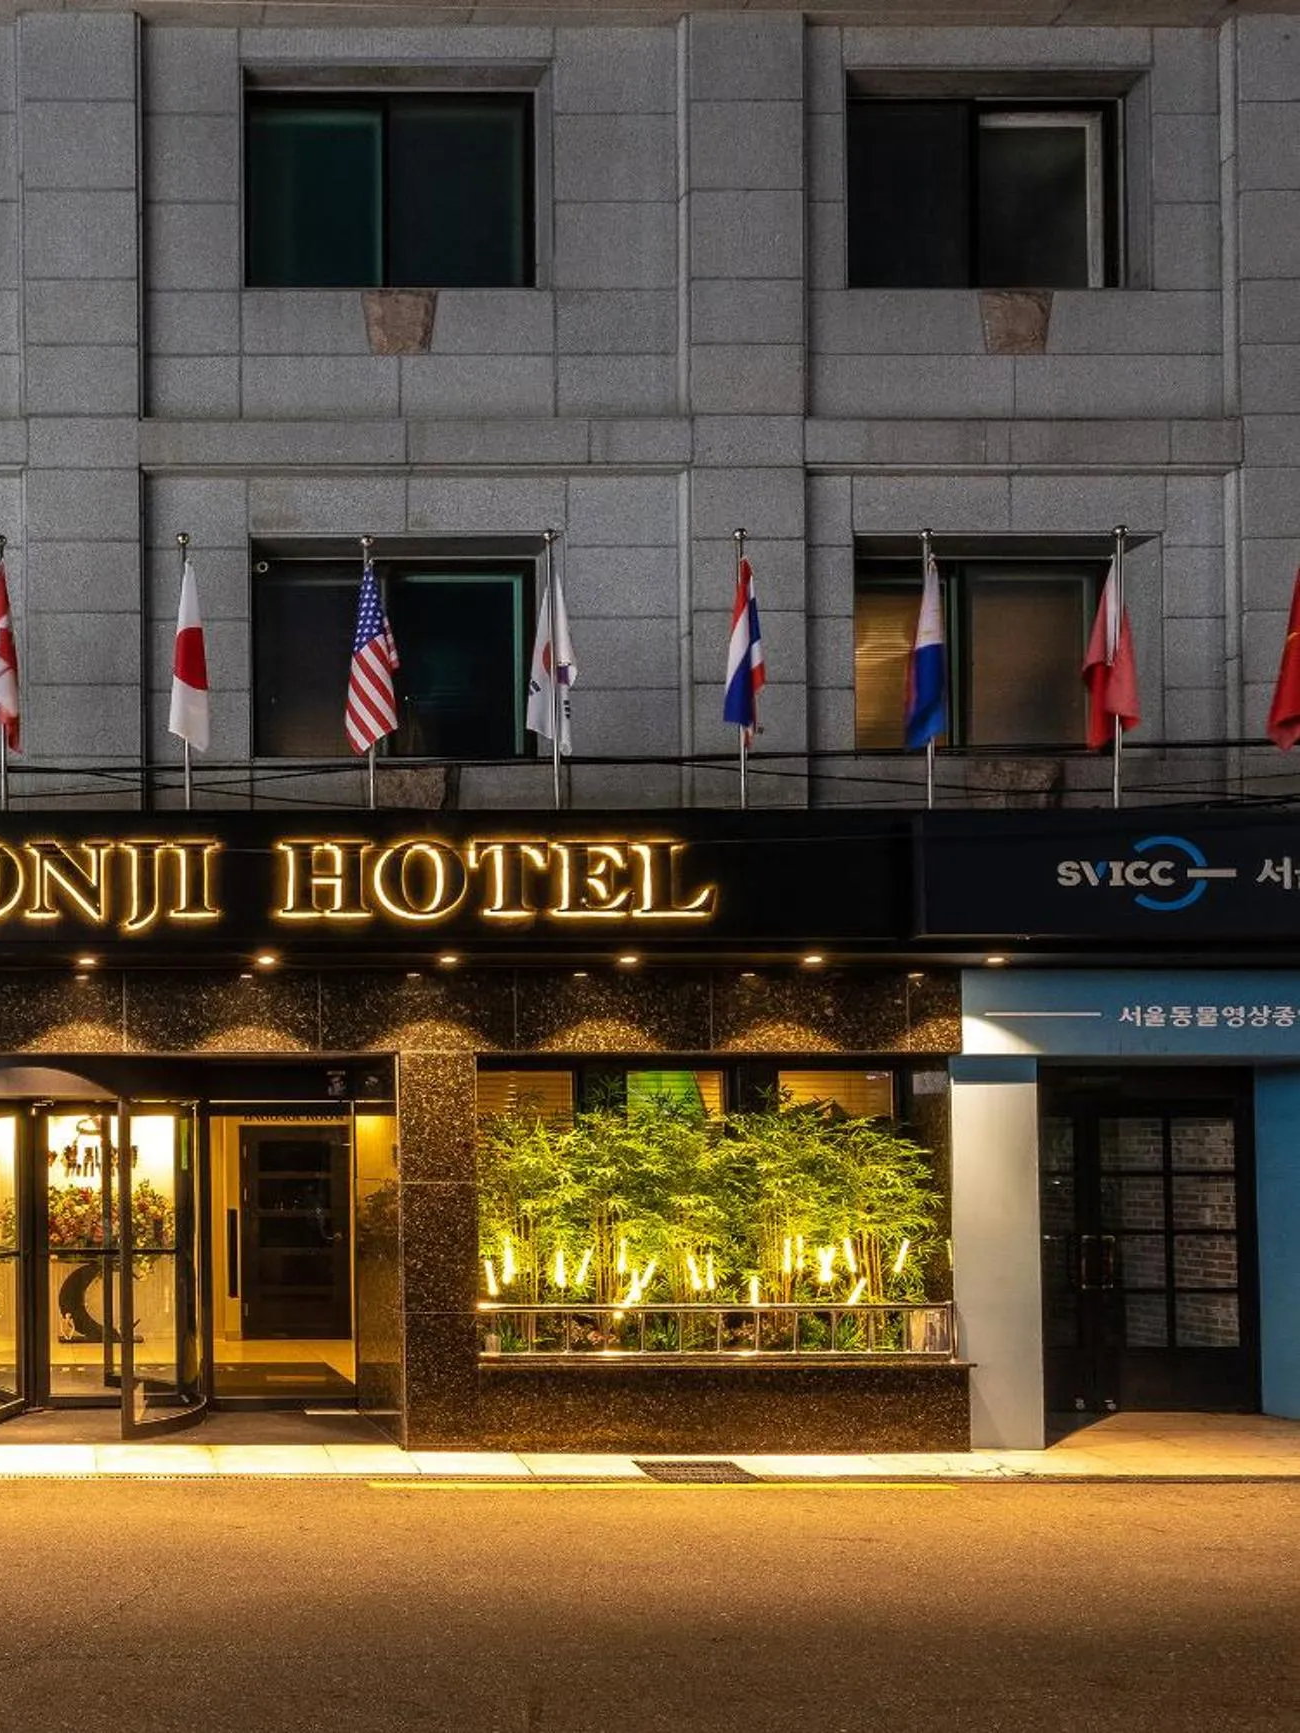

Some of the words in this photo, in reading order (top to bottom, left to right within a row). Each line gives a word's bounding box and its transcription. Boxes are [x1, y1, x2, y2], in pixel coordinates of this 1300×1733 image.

[275, 841, 713, 923] HOTEL
[1256, 857, 1300, 890] 서
[1119, 1006, 1300, 1028] 서울동물영상종
